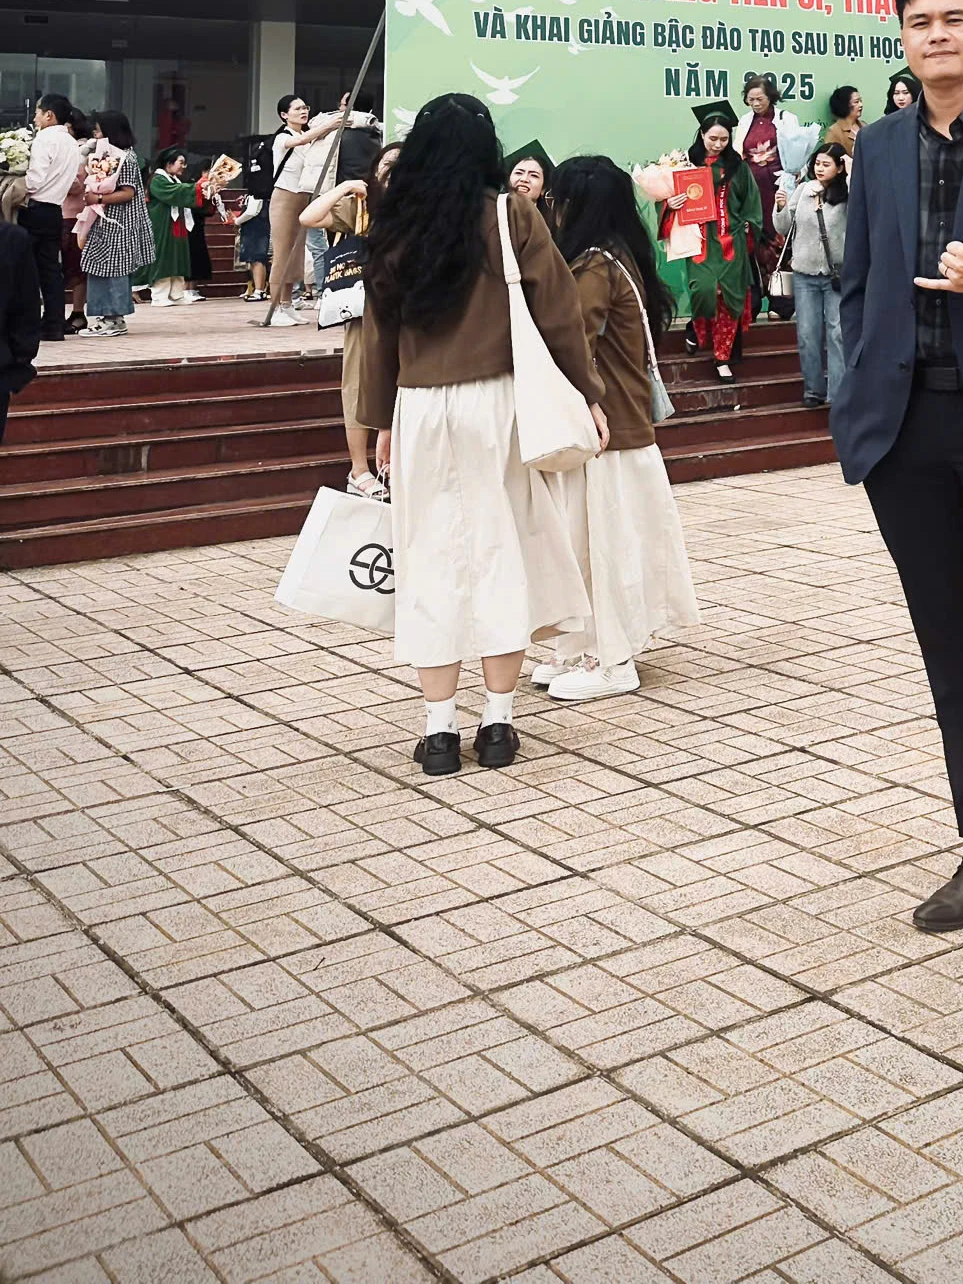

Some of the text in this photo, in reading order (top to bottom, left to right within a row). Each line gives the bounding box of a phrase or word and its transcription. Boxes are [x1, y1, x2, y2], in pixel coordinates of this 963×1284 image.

[473, 5, 905, 64] VÀ KHAI GIẢNG BẬC ĐÀO TẠO SAU ĐẠI HỌC
[665, 62, 728, 98] NĂM
